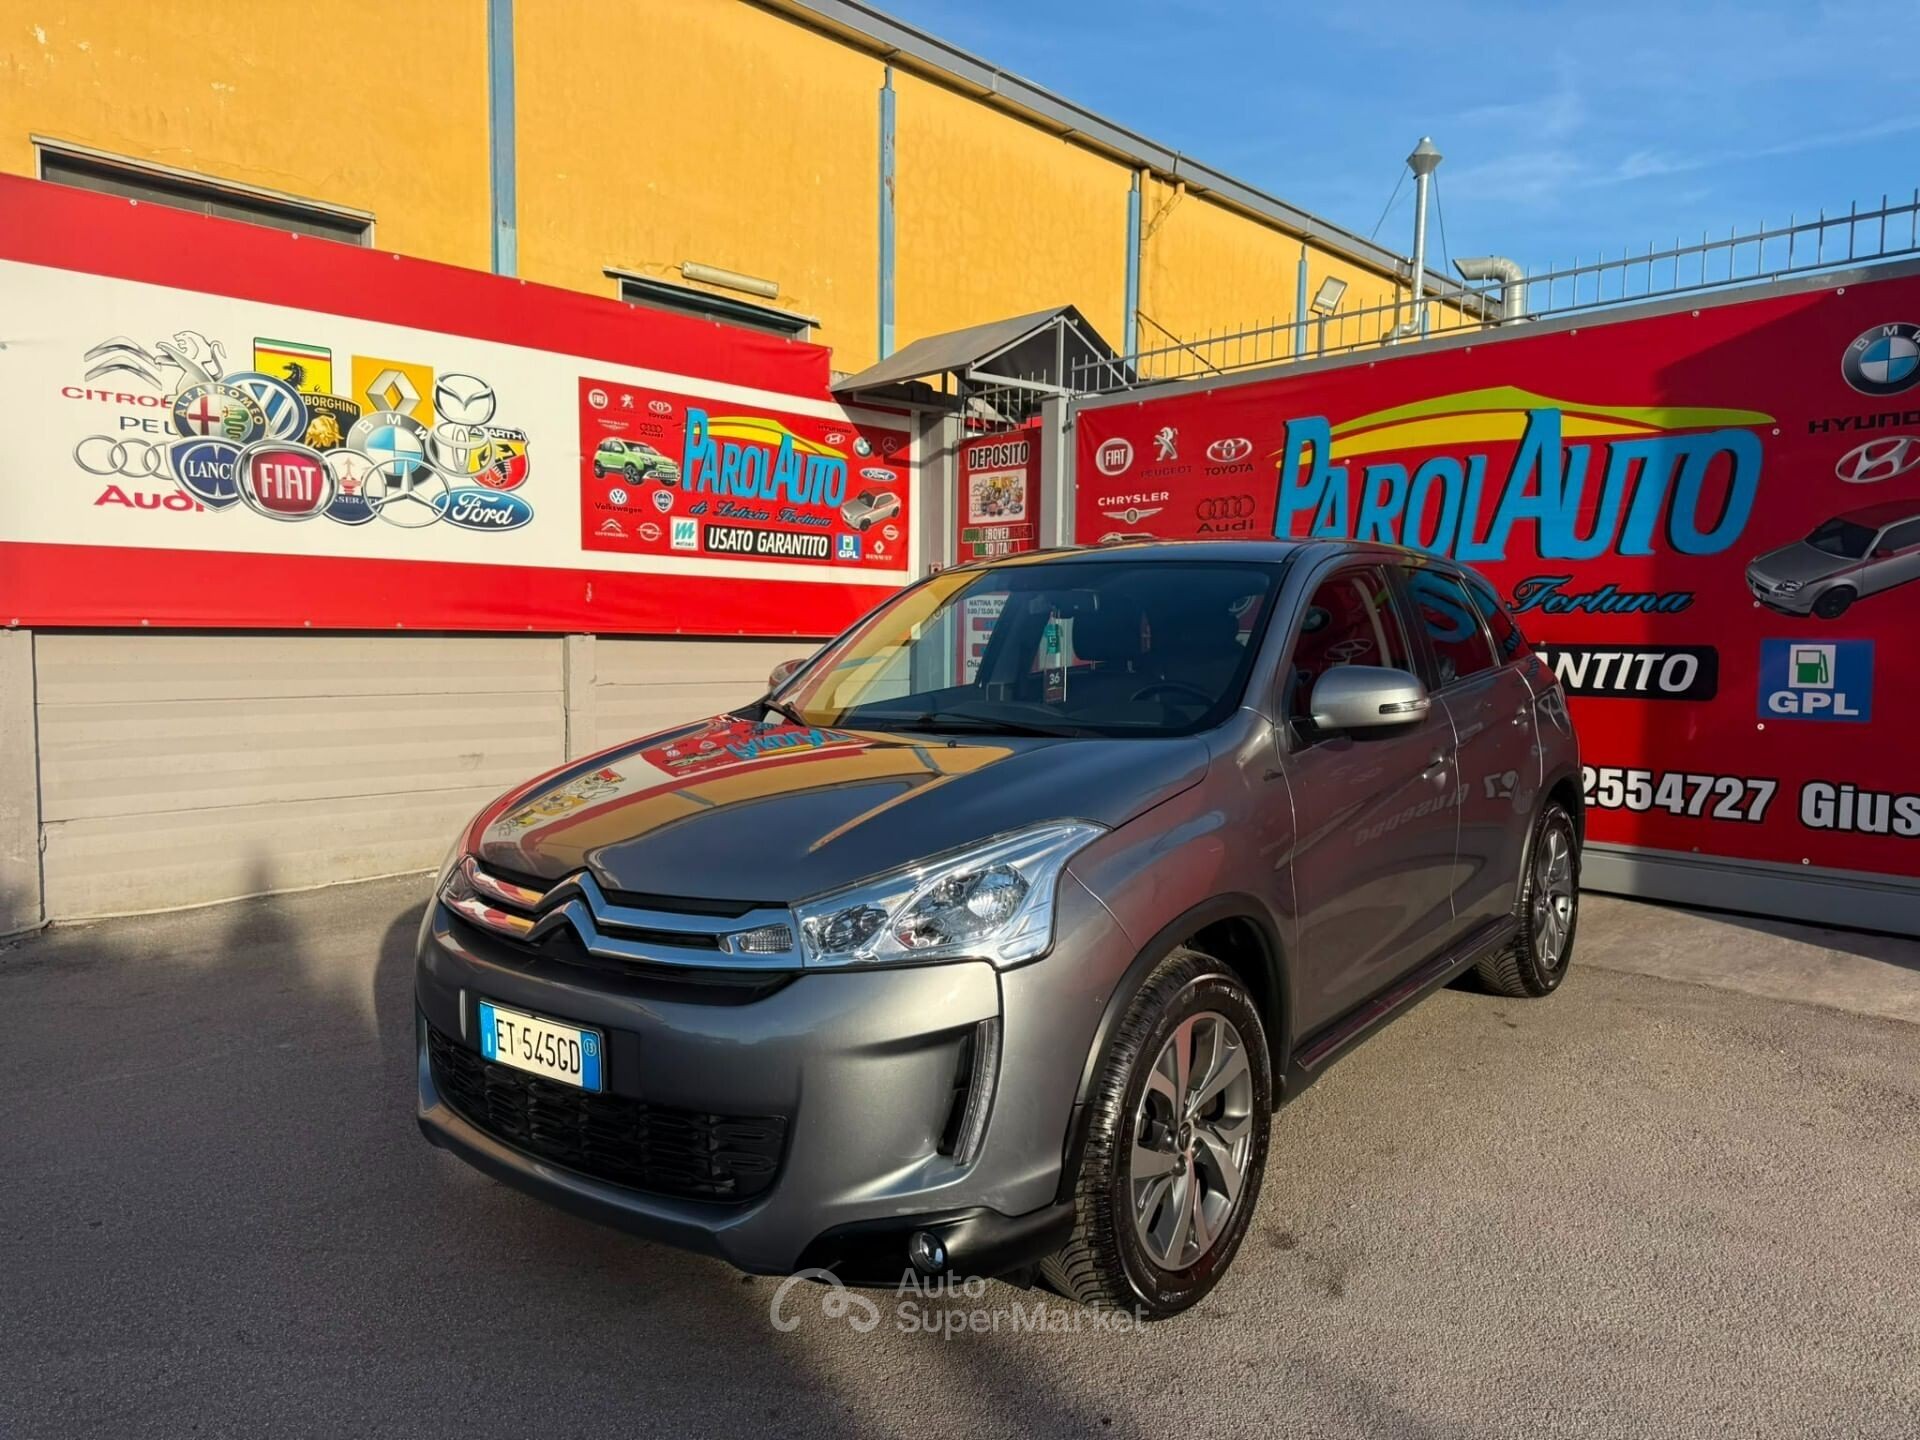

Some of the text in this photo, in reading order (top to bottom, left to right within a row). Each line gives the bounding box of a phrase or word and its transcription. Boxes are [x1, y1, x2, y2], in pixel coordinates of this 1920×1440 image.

[217, 386, 263, 424] ROMEO
[968, 440, 1030, 471] DEPOSITO
[1105, 449, 1126, 467] FIAT
[1204, 463, 1254, 477] TOYOTA
[260, 463, 317, 501] FIAT
[452, 493, 514, 525] Ford
[689, 500, 709, 516] di
[1097, 491, 1170, 507] CHRYSLER
[1195, 519, 1255, 534] Audi
[708, 526, 829, 557] USATO GARANTITO
[838, 549, 859, 560] GPL
[1505, 574, 1696, 615] Fortuna
[1767, 690, 1860, 717] GPL
[495, 1018, 516, 1056] ET
[523, 1027, 581, 1074] 545GD
